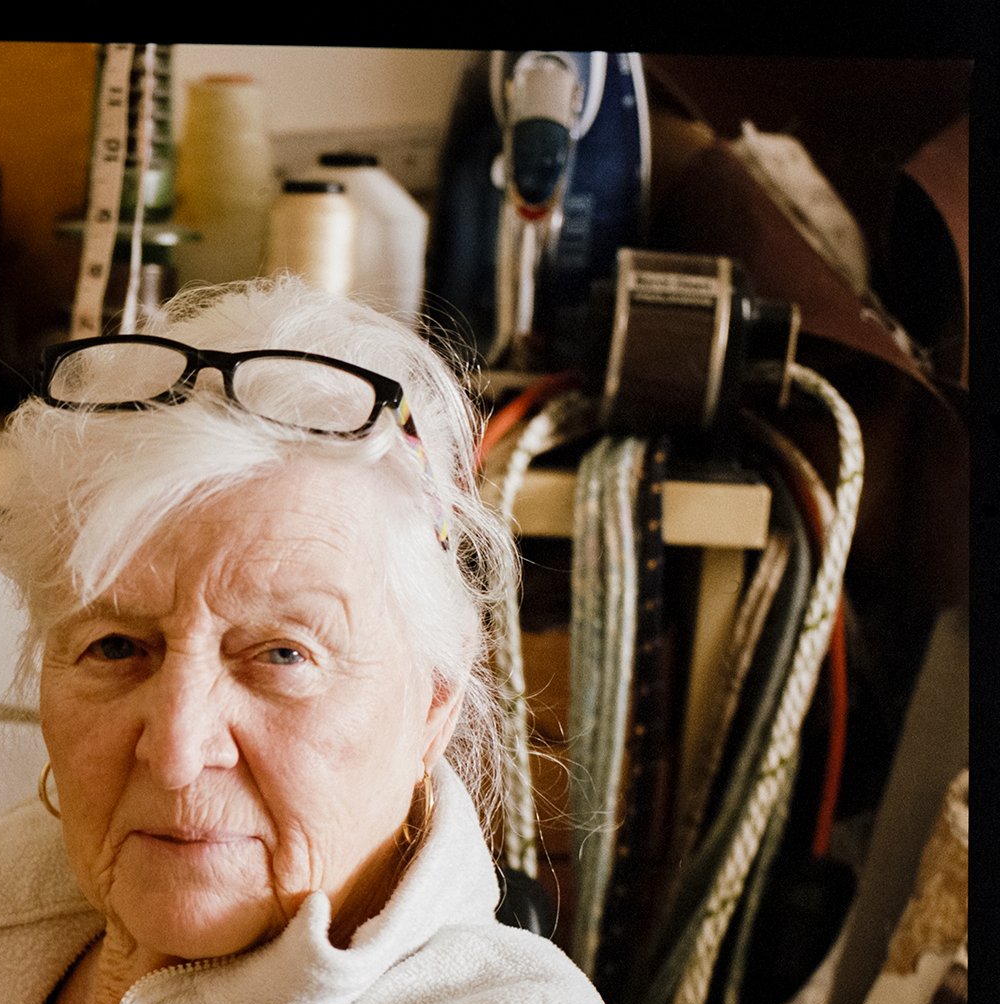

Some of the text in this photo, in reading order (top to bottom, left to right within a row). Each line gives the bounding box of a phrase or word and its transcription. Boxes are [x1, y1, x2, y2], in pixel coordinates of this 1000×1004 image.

[107, 87, 122, 106] 11
[104, 139, 120, 161] 10
[98, 209, 111, 222] 9
